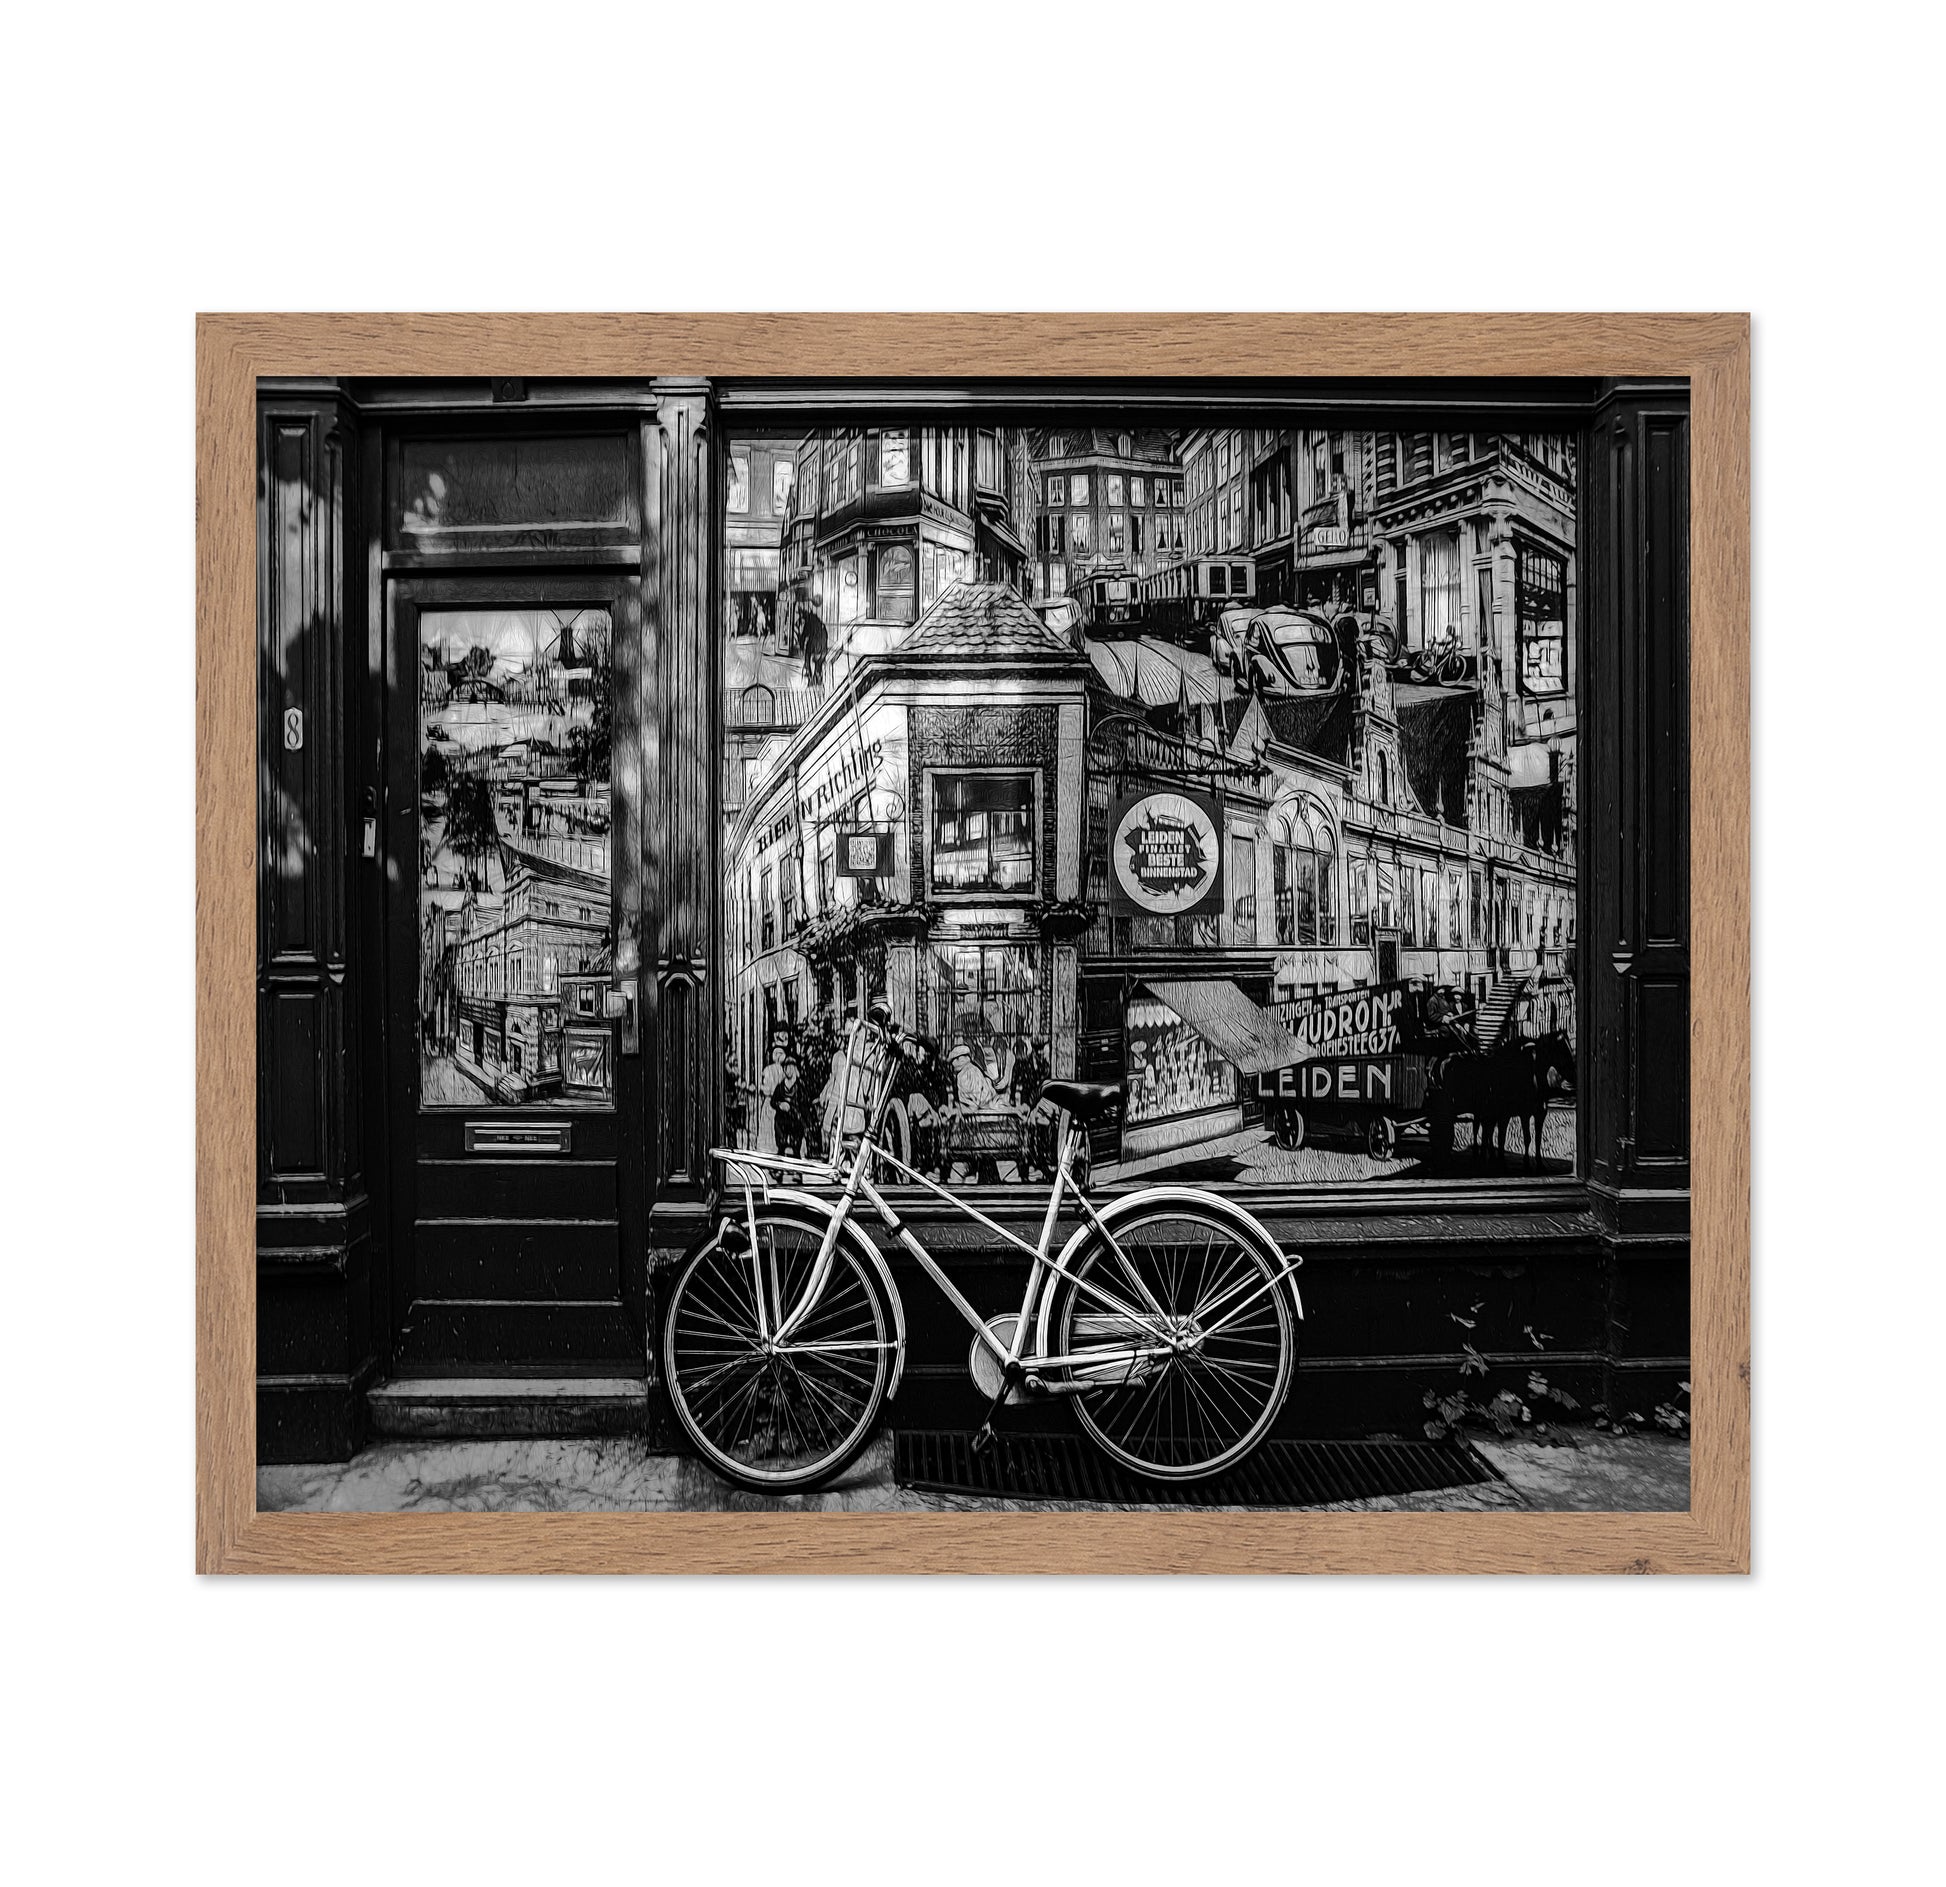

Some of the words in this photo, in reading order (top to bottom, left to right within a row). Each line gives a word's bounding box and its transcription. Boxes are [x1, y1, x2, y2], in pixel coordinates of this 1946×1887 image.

[287, 712, 300, 749] 8
[1141, 830, 1185, 845] LEIDEN
[1138, 844, 1191, 854] FINALIST
[1147, 853, 1185, 867] BESTE
[1140, 866, 1198, 878] BINNENSTAD
[1258, 1064, 1391, 1098] LEIDEN
